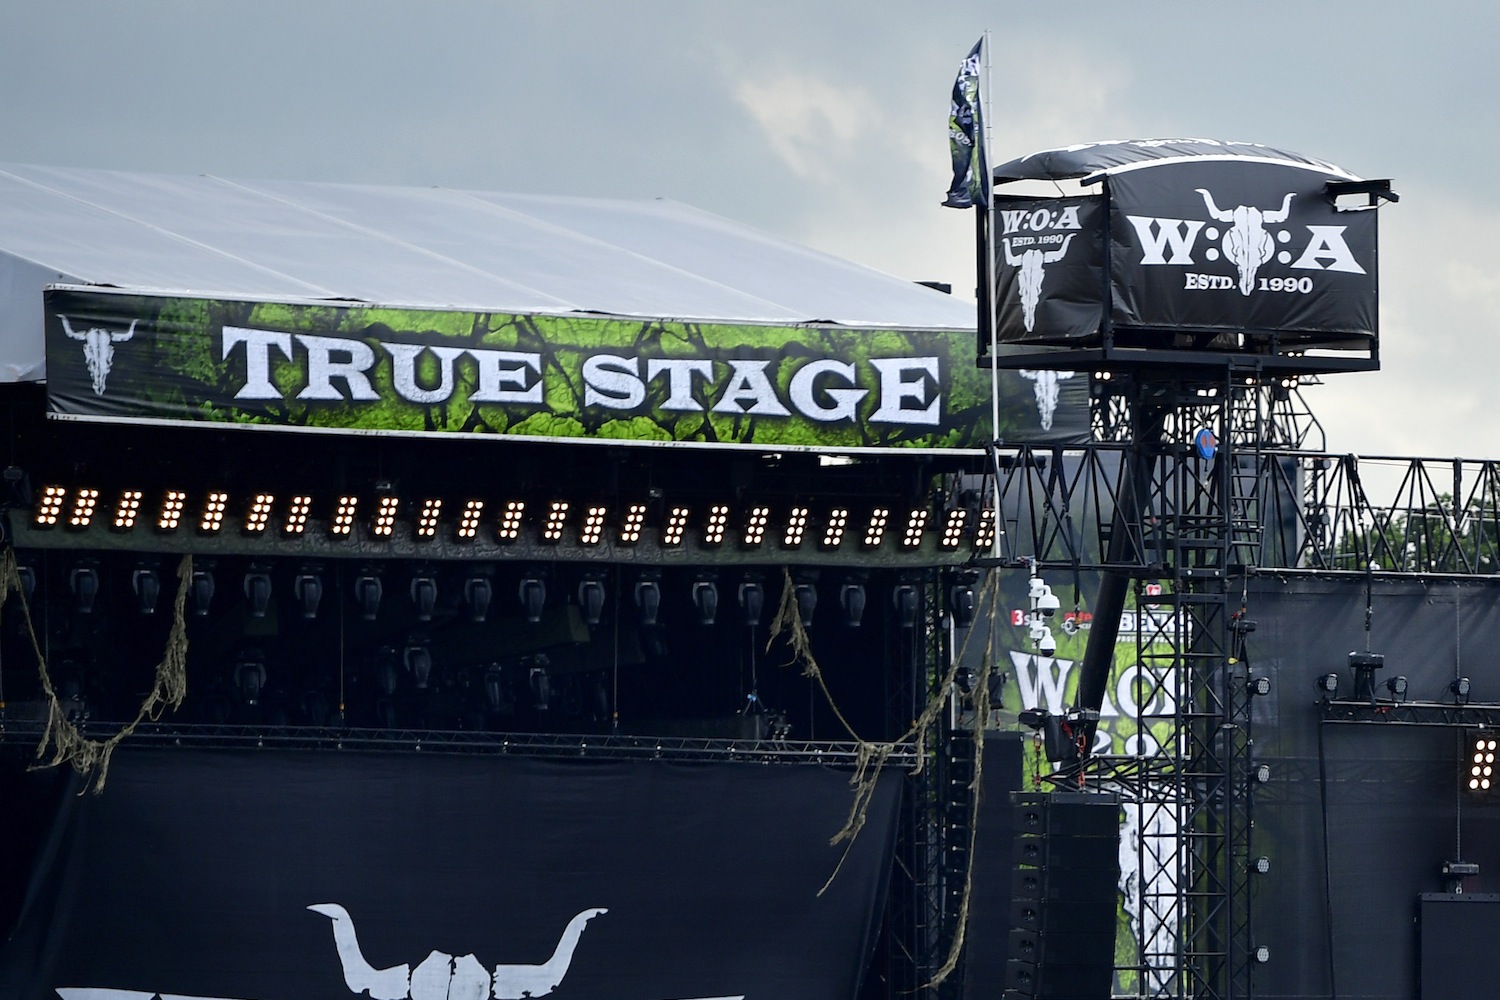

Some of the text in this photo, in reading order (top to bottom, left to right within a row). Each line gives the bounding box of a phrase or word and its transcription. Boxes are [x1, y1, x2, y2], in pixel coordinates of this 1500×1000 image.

[1012, 233, 1064, 247] ESTD. 1990
[1184, 272, 1314, 294] ESTD. 1990
[222, 325, 941, 426] TRUE STAGE
